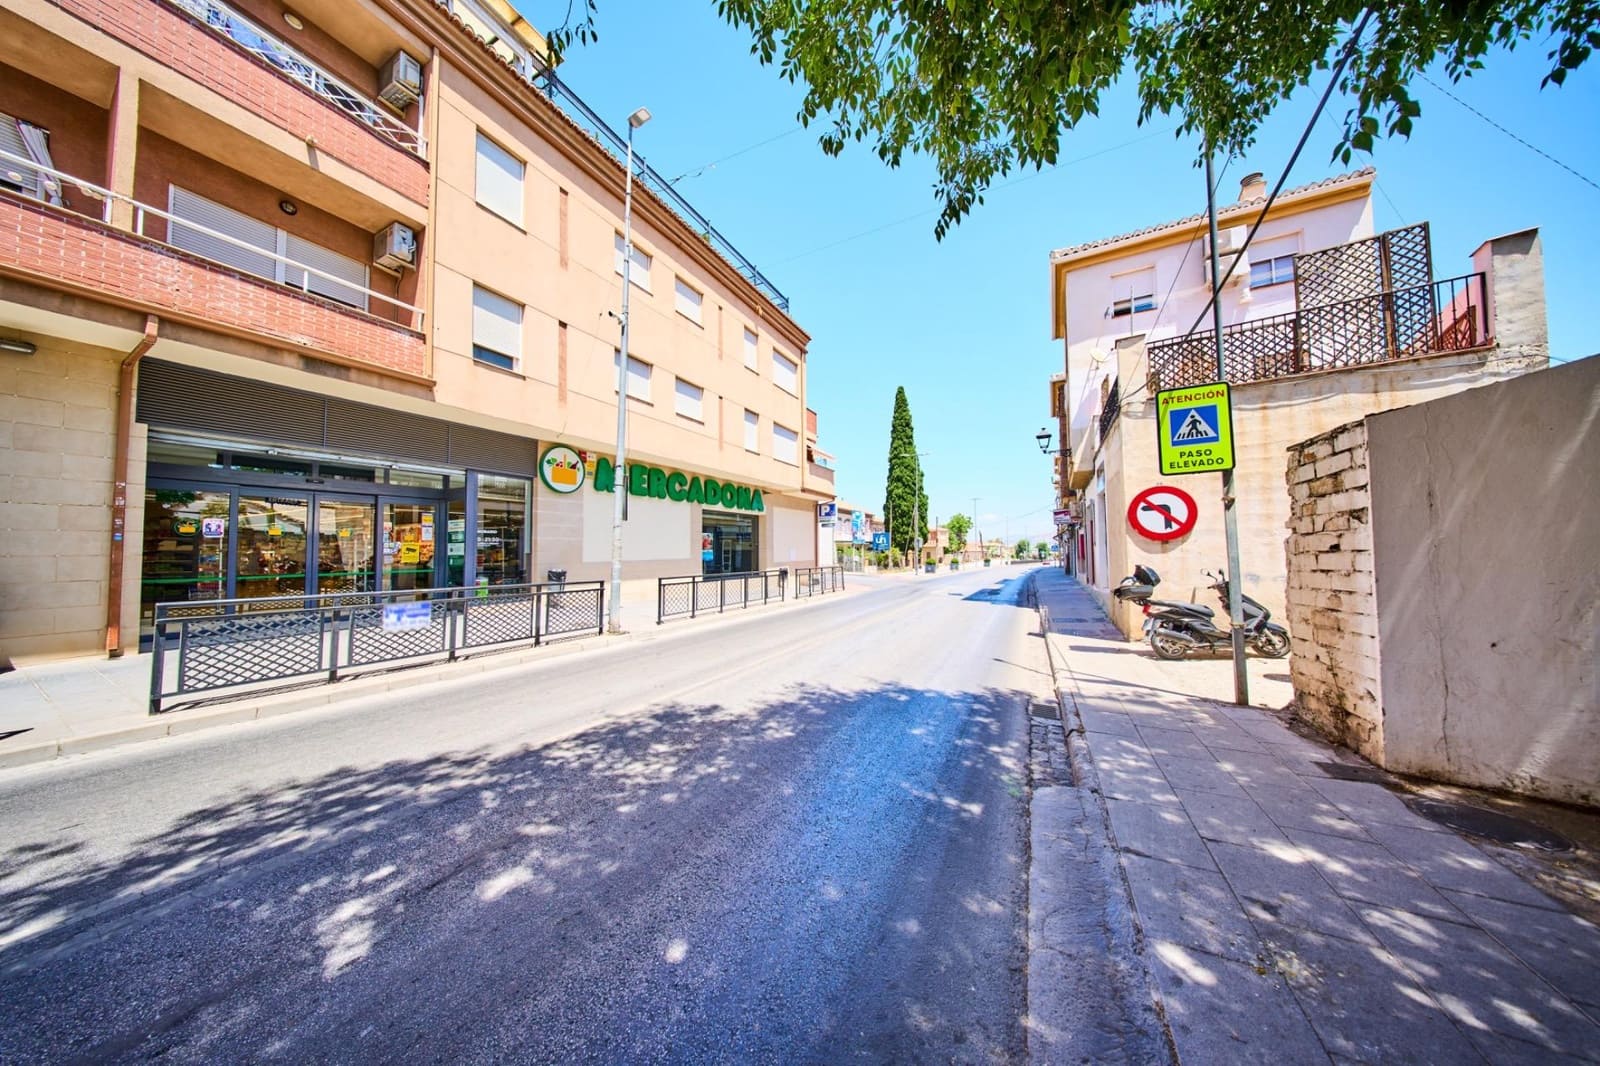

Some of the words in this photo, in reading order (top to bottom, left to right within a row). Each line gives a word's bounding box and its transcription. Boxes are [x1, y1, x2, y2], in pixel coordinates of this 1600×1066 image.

[1162, 389, 1225, 405] ATENCIÓN
[1179, 449, 1212, 459] PASO
[1169, 457, 1225, 469] ELEVADO
[820, 504, 831, 517] P
